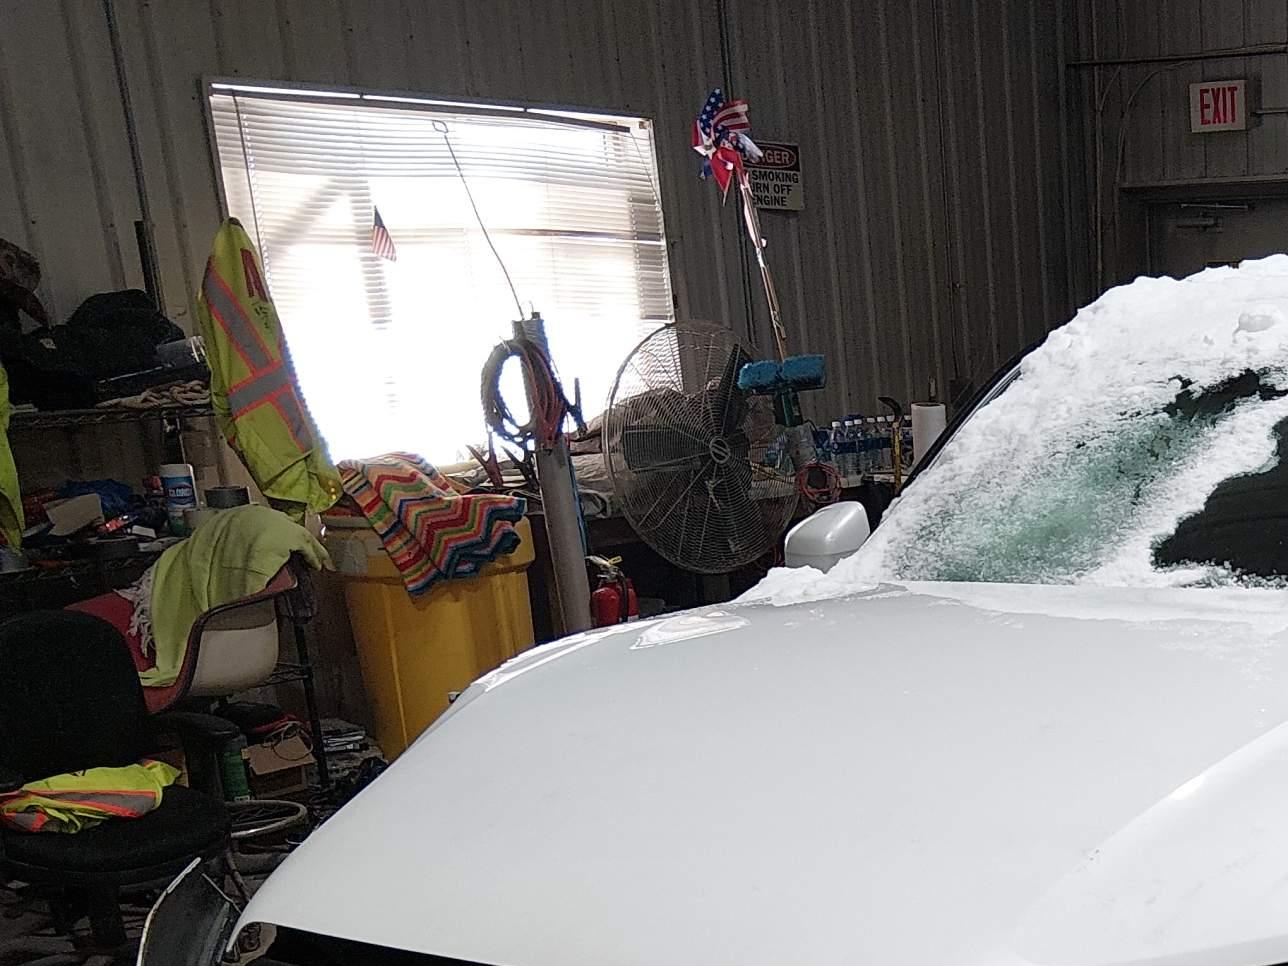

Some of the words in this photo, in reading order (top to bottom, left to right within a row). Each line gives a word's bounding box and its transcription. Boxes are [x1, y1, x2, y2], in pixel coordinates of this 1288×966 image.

[1199, 86, 1238, 125] EXIT
[751, 170, 799, 183] SMOKING
[751, 182, 769, 194] URN
[773, 184, 792, 195] OFF
[752, 194, 787, 207] ENGINE
